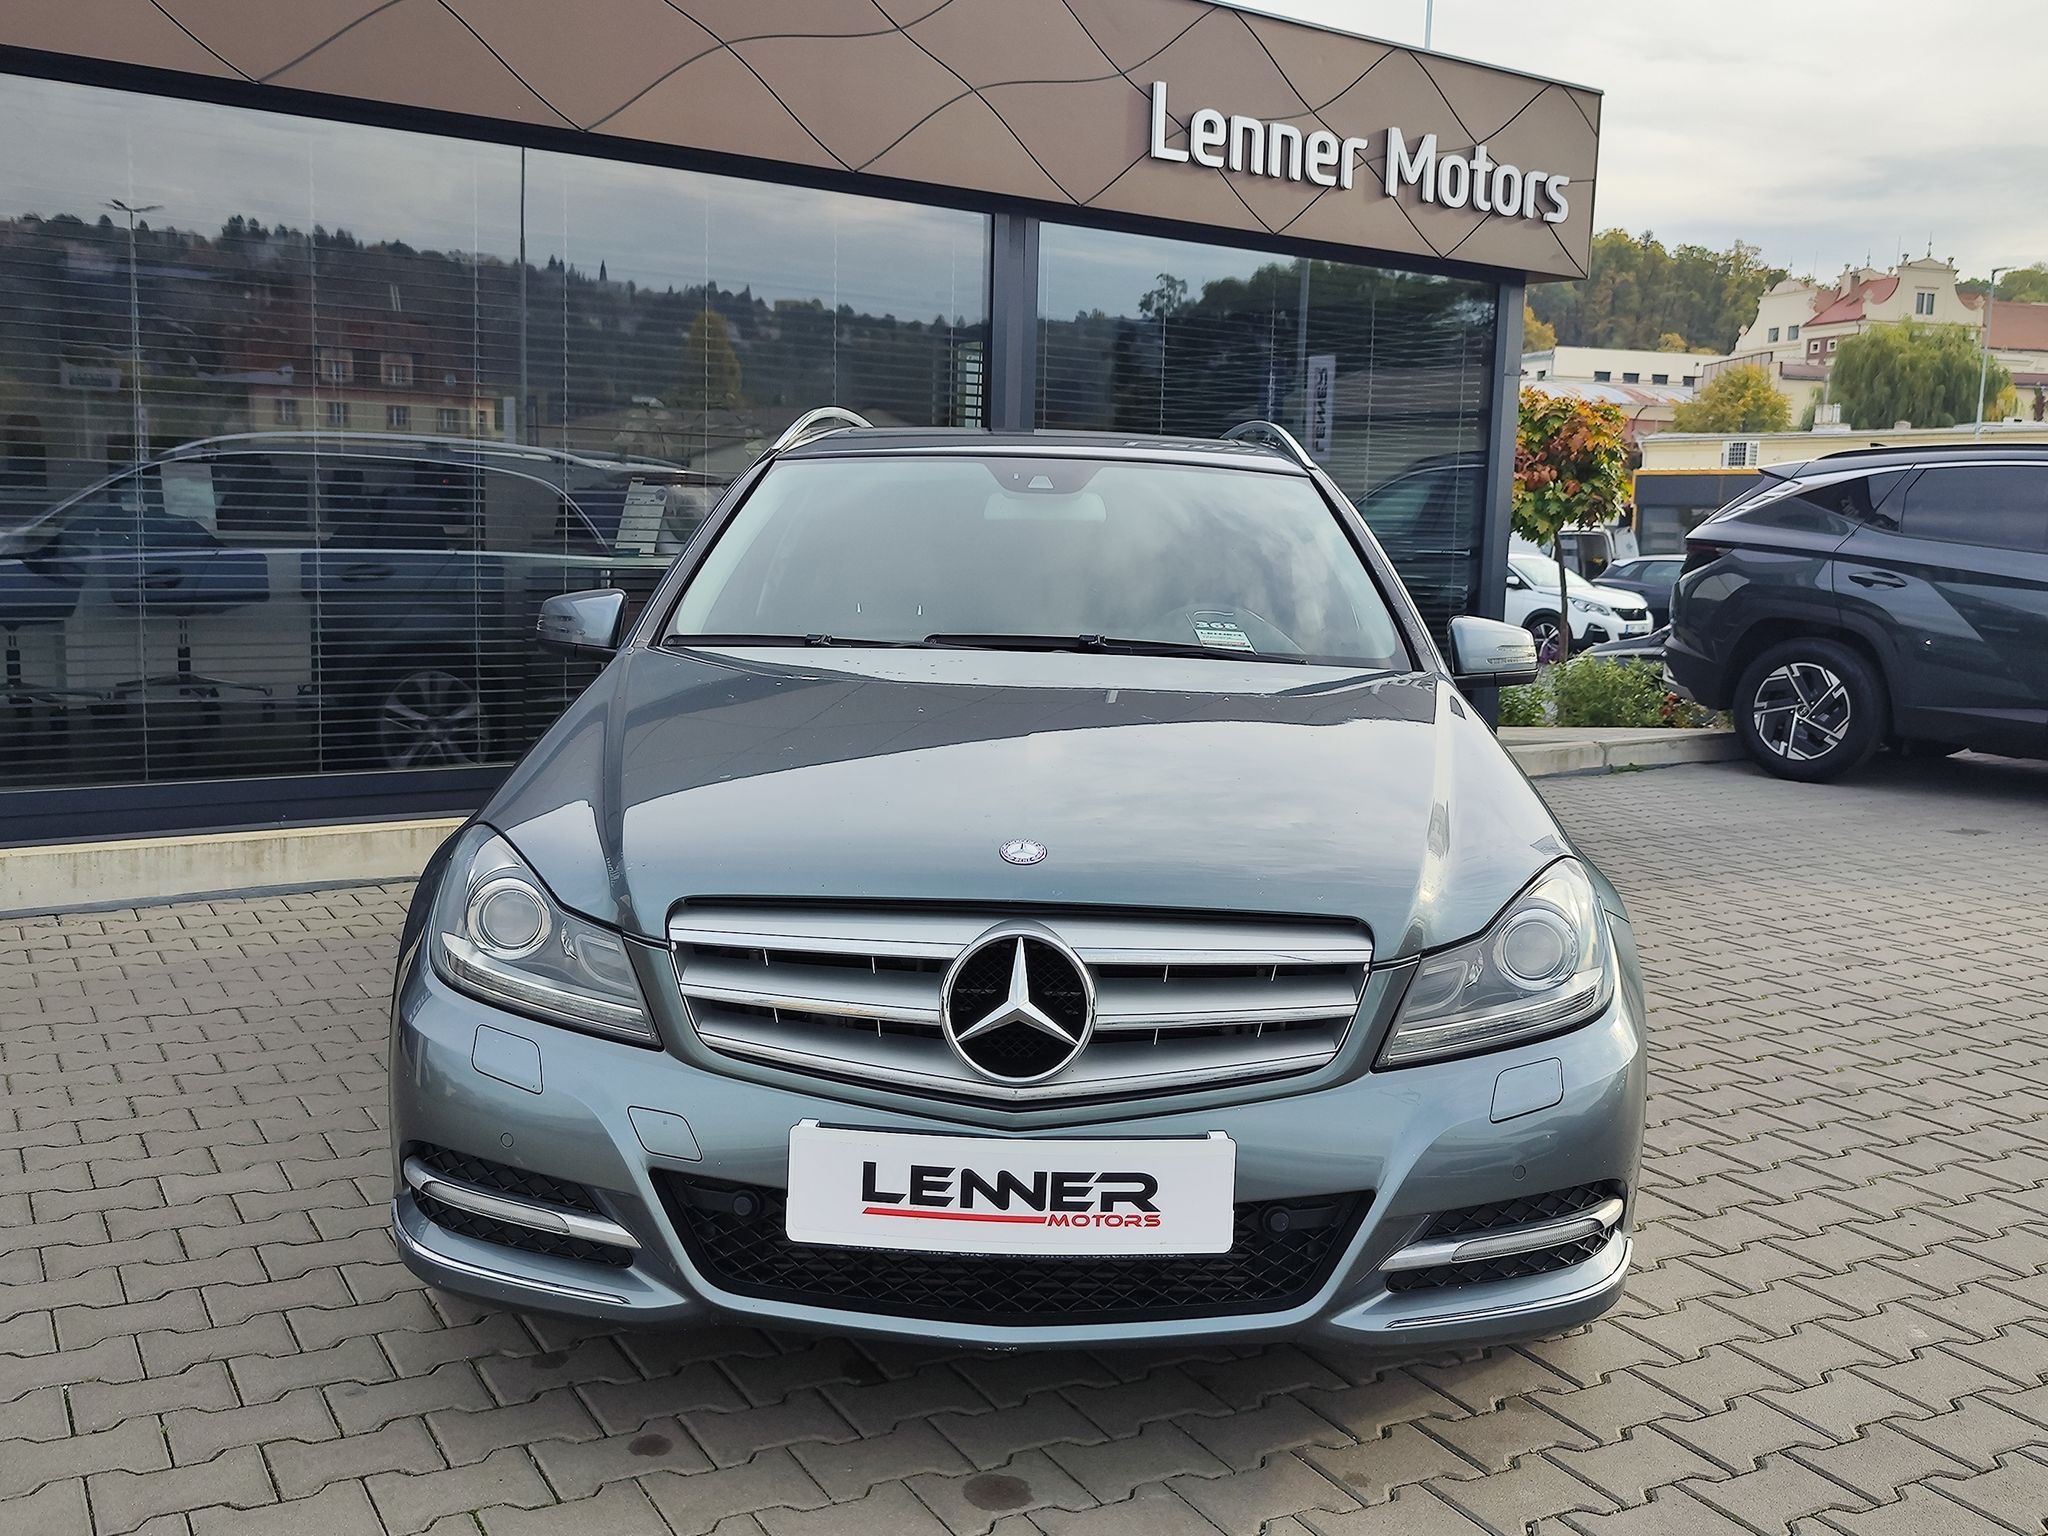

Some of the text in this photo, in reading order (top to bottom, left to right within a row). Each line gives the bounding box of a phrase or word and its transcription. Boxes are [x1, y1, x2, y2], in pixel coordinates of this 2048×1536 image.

[1151, 81, 1570, 223] Lenner Motors
[862, 1161, 1159, 1212] LENNER
[1047, 1213, 1161, 1227] MOTORS
